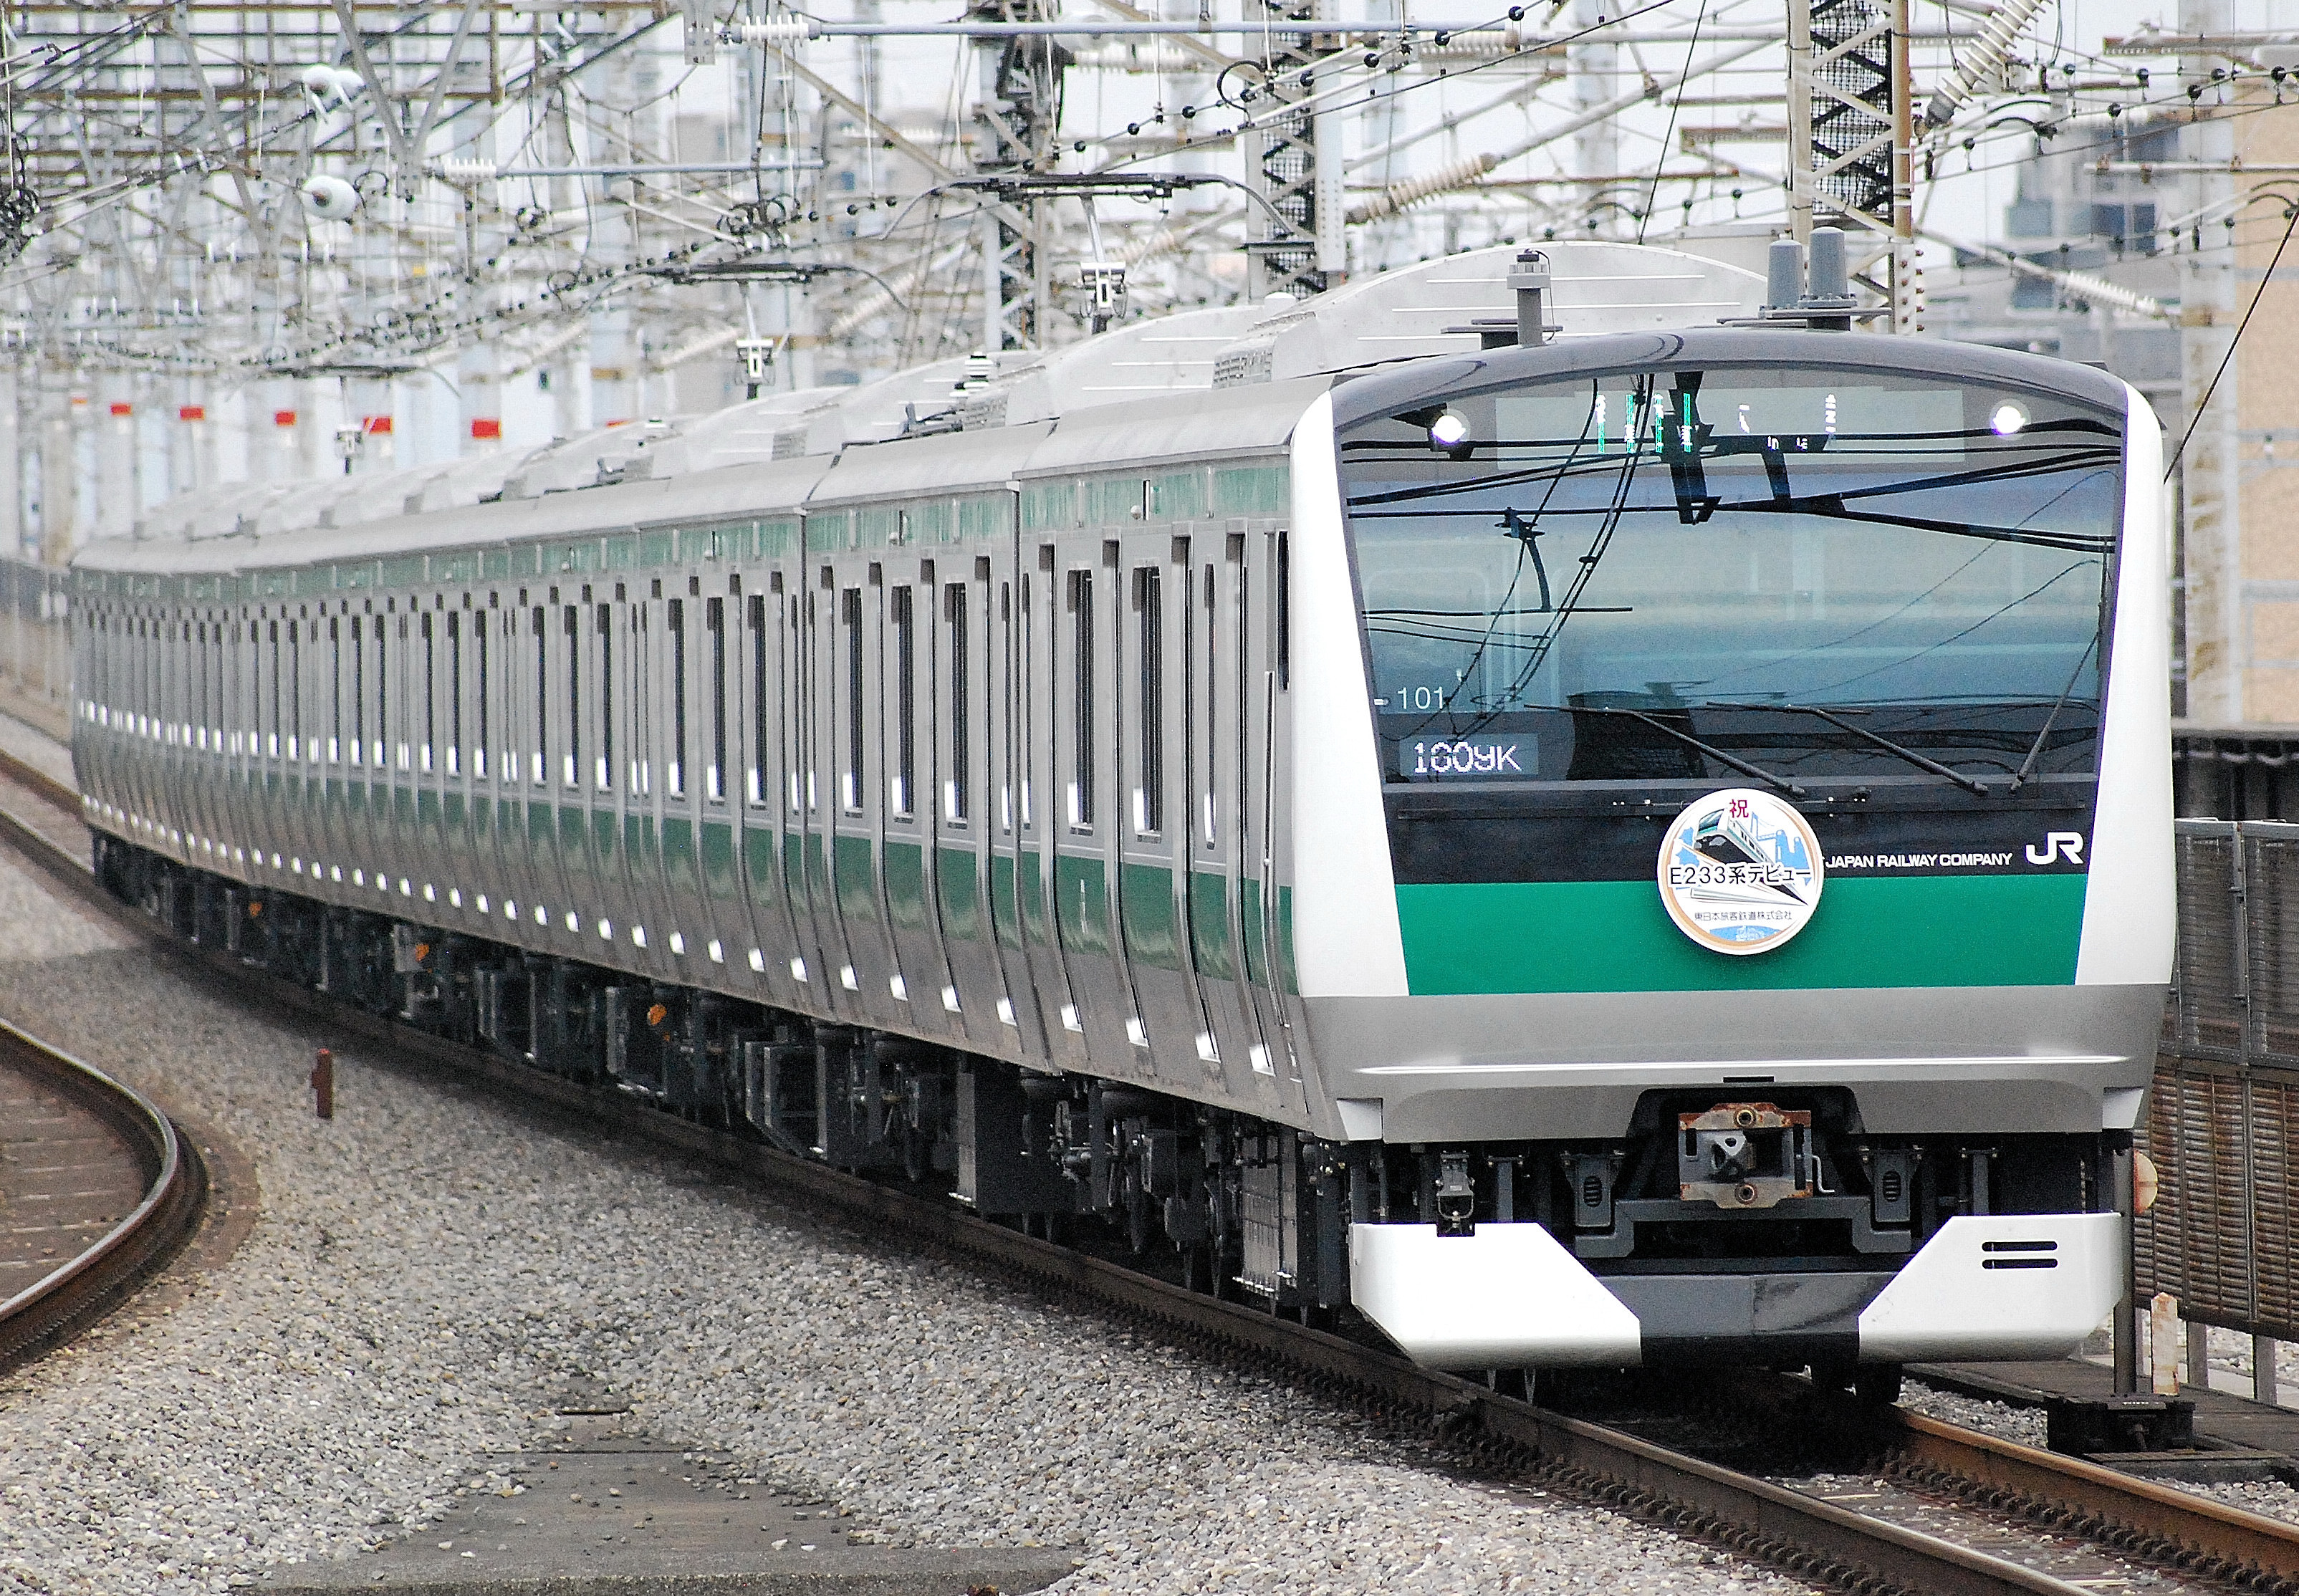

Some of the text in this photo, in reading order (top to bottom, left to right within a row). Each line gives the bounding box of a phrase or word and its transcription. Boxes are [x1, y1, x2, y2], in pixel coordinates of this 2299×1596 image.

[1397, 686, 1444, 709] 101
[1729, 799, 1750, 818] 祝
[2025, 832, 2083, 865] JR
[1825, 852, 2013, 868] JAPAN RAILWAY COMPANY
[1670, 865, 1811, 885] E233系デビュー
[1694, 910, 1792, 921] 東日本旅客鉄道株式会社
